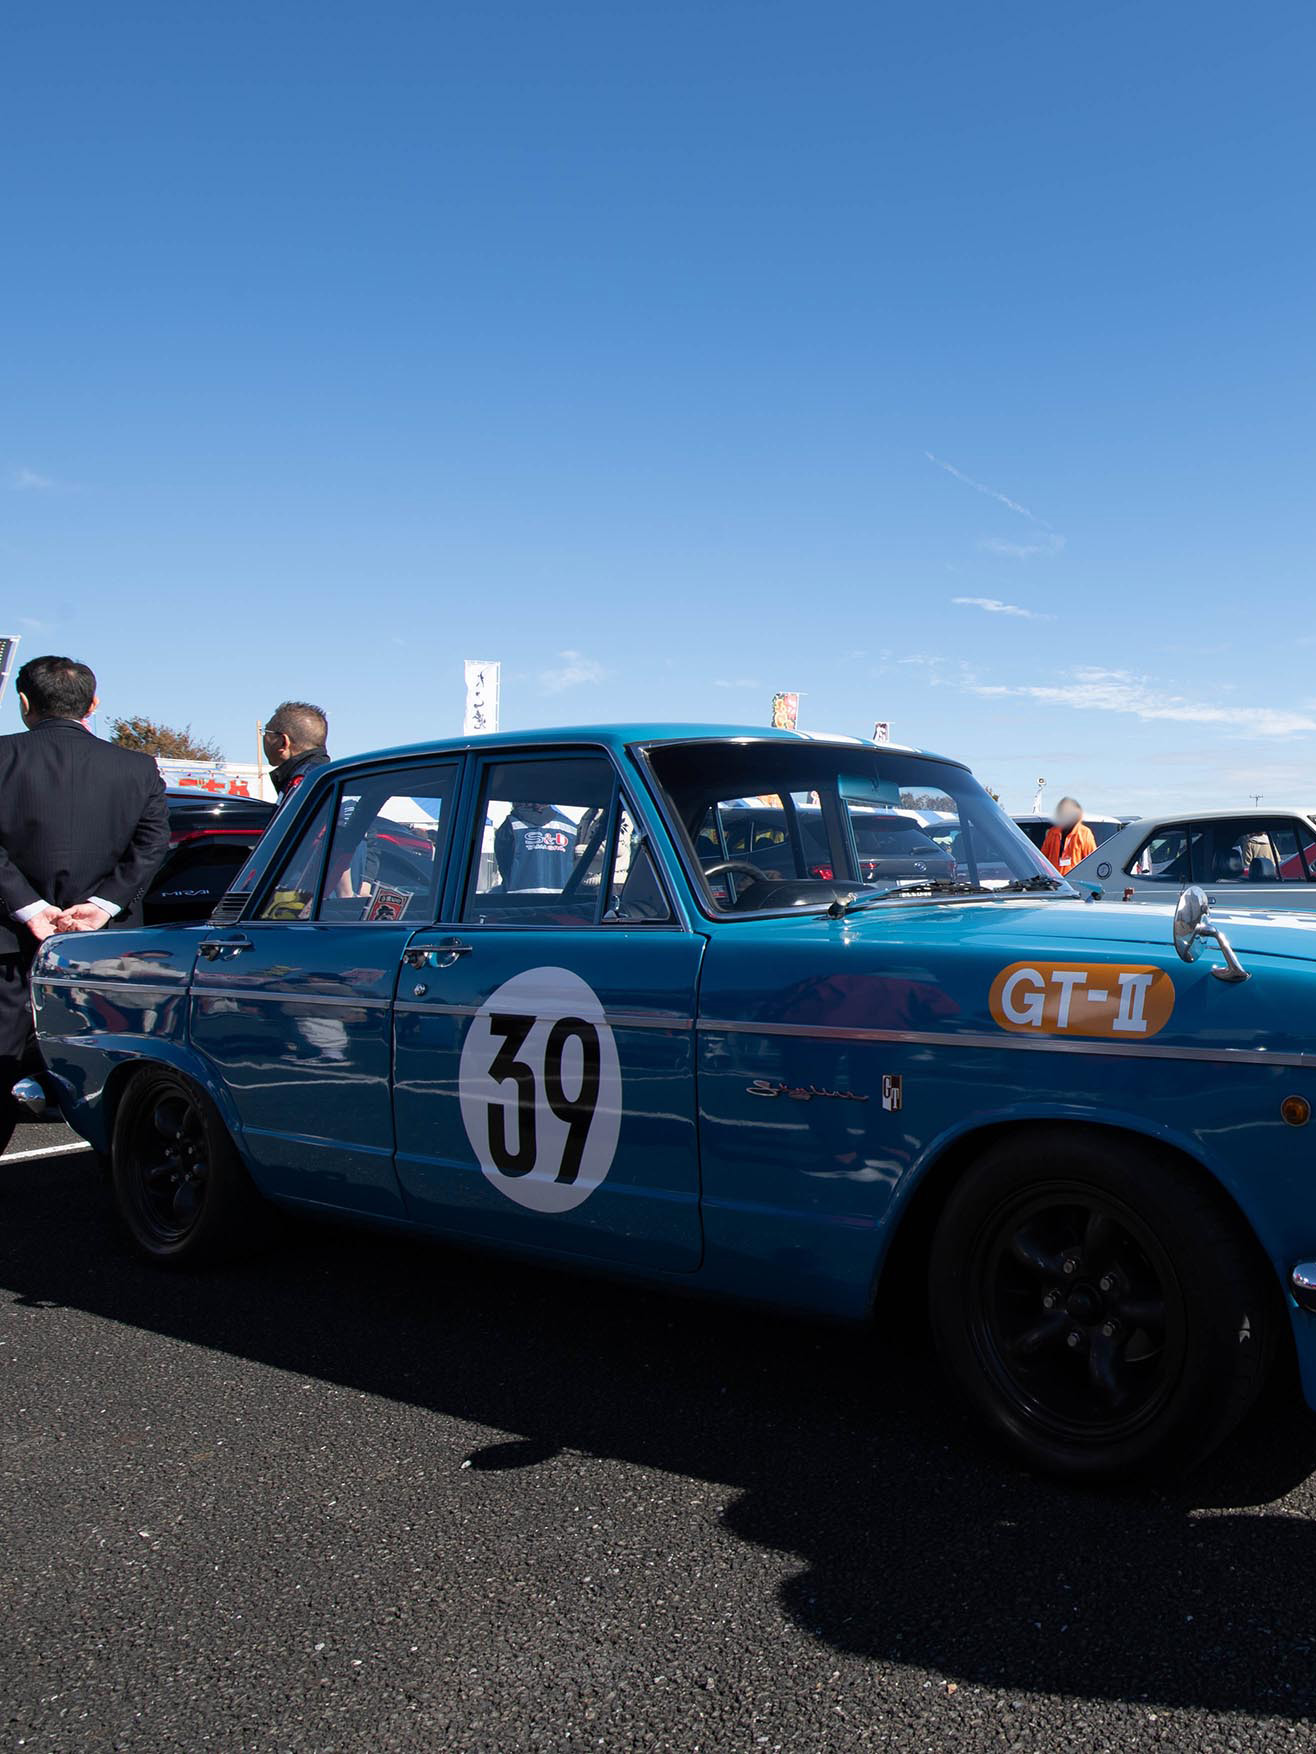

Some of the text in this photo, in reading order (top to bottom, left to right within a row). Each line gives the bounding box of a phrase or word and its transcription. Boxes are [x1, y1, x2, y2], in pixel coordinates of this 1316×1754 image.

[161, 889, 210, 897] MIRAI
[487, 1012, 601, 1185] 39
[882, 1076, 901, 1111] GT
